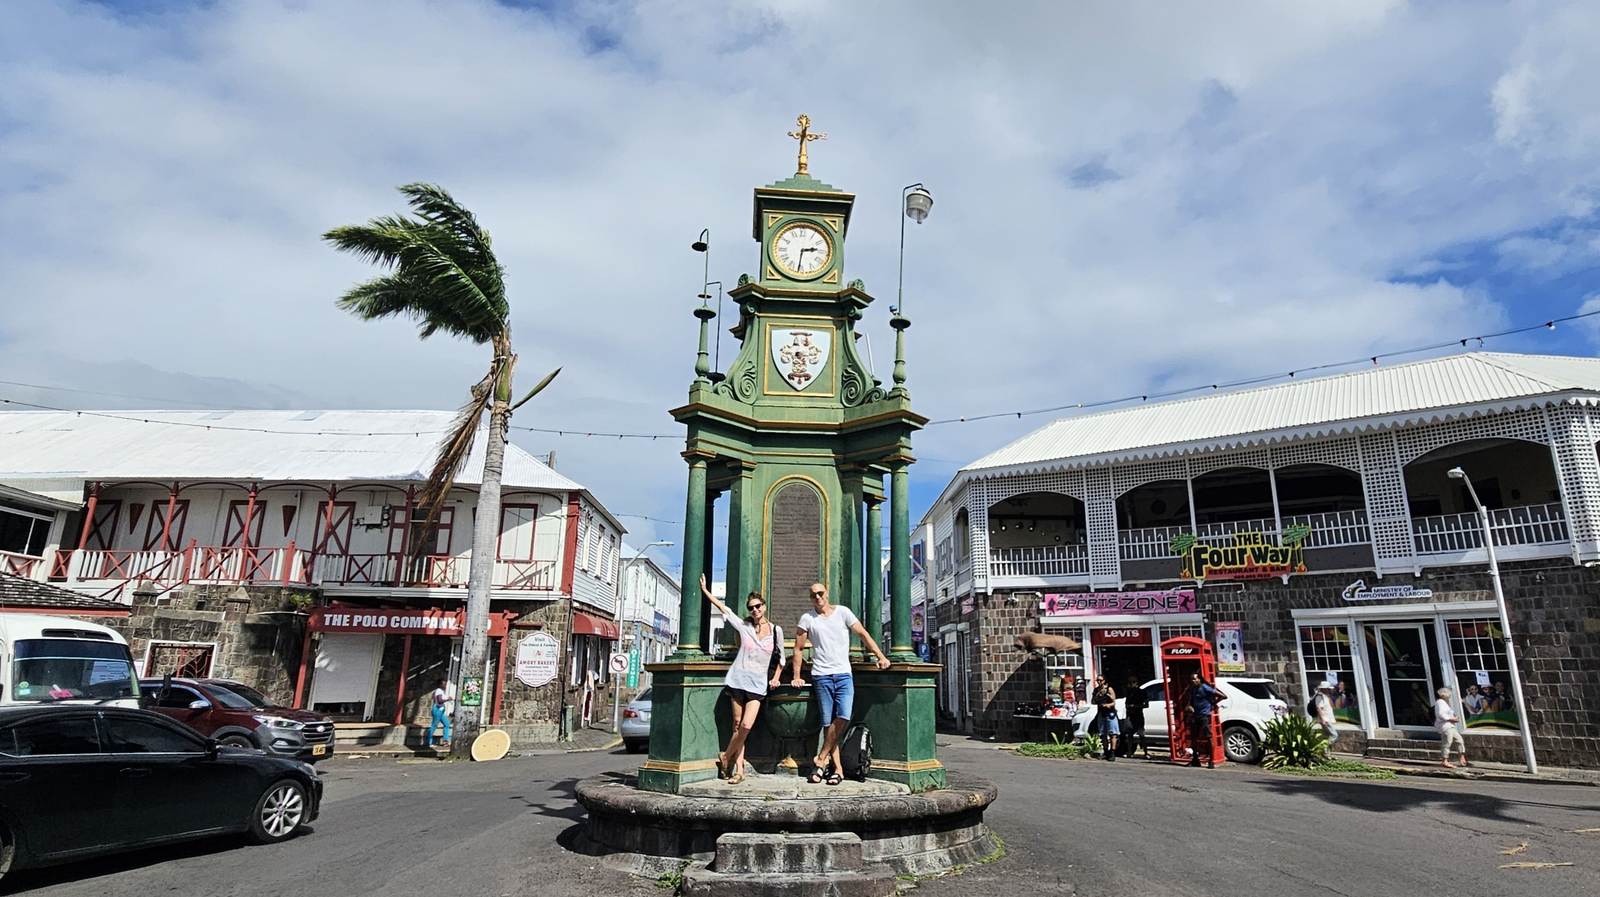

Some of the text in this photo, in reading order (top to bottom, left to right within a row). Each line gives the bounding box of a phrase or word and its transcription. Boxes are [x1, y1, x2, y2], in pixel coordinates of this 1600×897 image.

[1236, 533, 1260, 545] THE
[1192, 546, 1290, 577] Four Way
[1208, 566, 1259, 576] RESTAURANT
[1357, 591, 1398, 599] EMPLOYMENT
[1405, 590, 1431, 598] LABOUR
[1373, 586, 1402, 594] MINISTRY
[1056, 596, 1179, 611] SPORTS ZONE
[323, 613, 351, 626] THE
[352, 615, 388, 628] POLO
[389, 616, 457, 630] COMPANY
